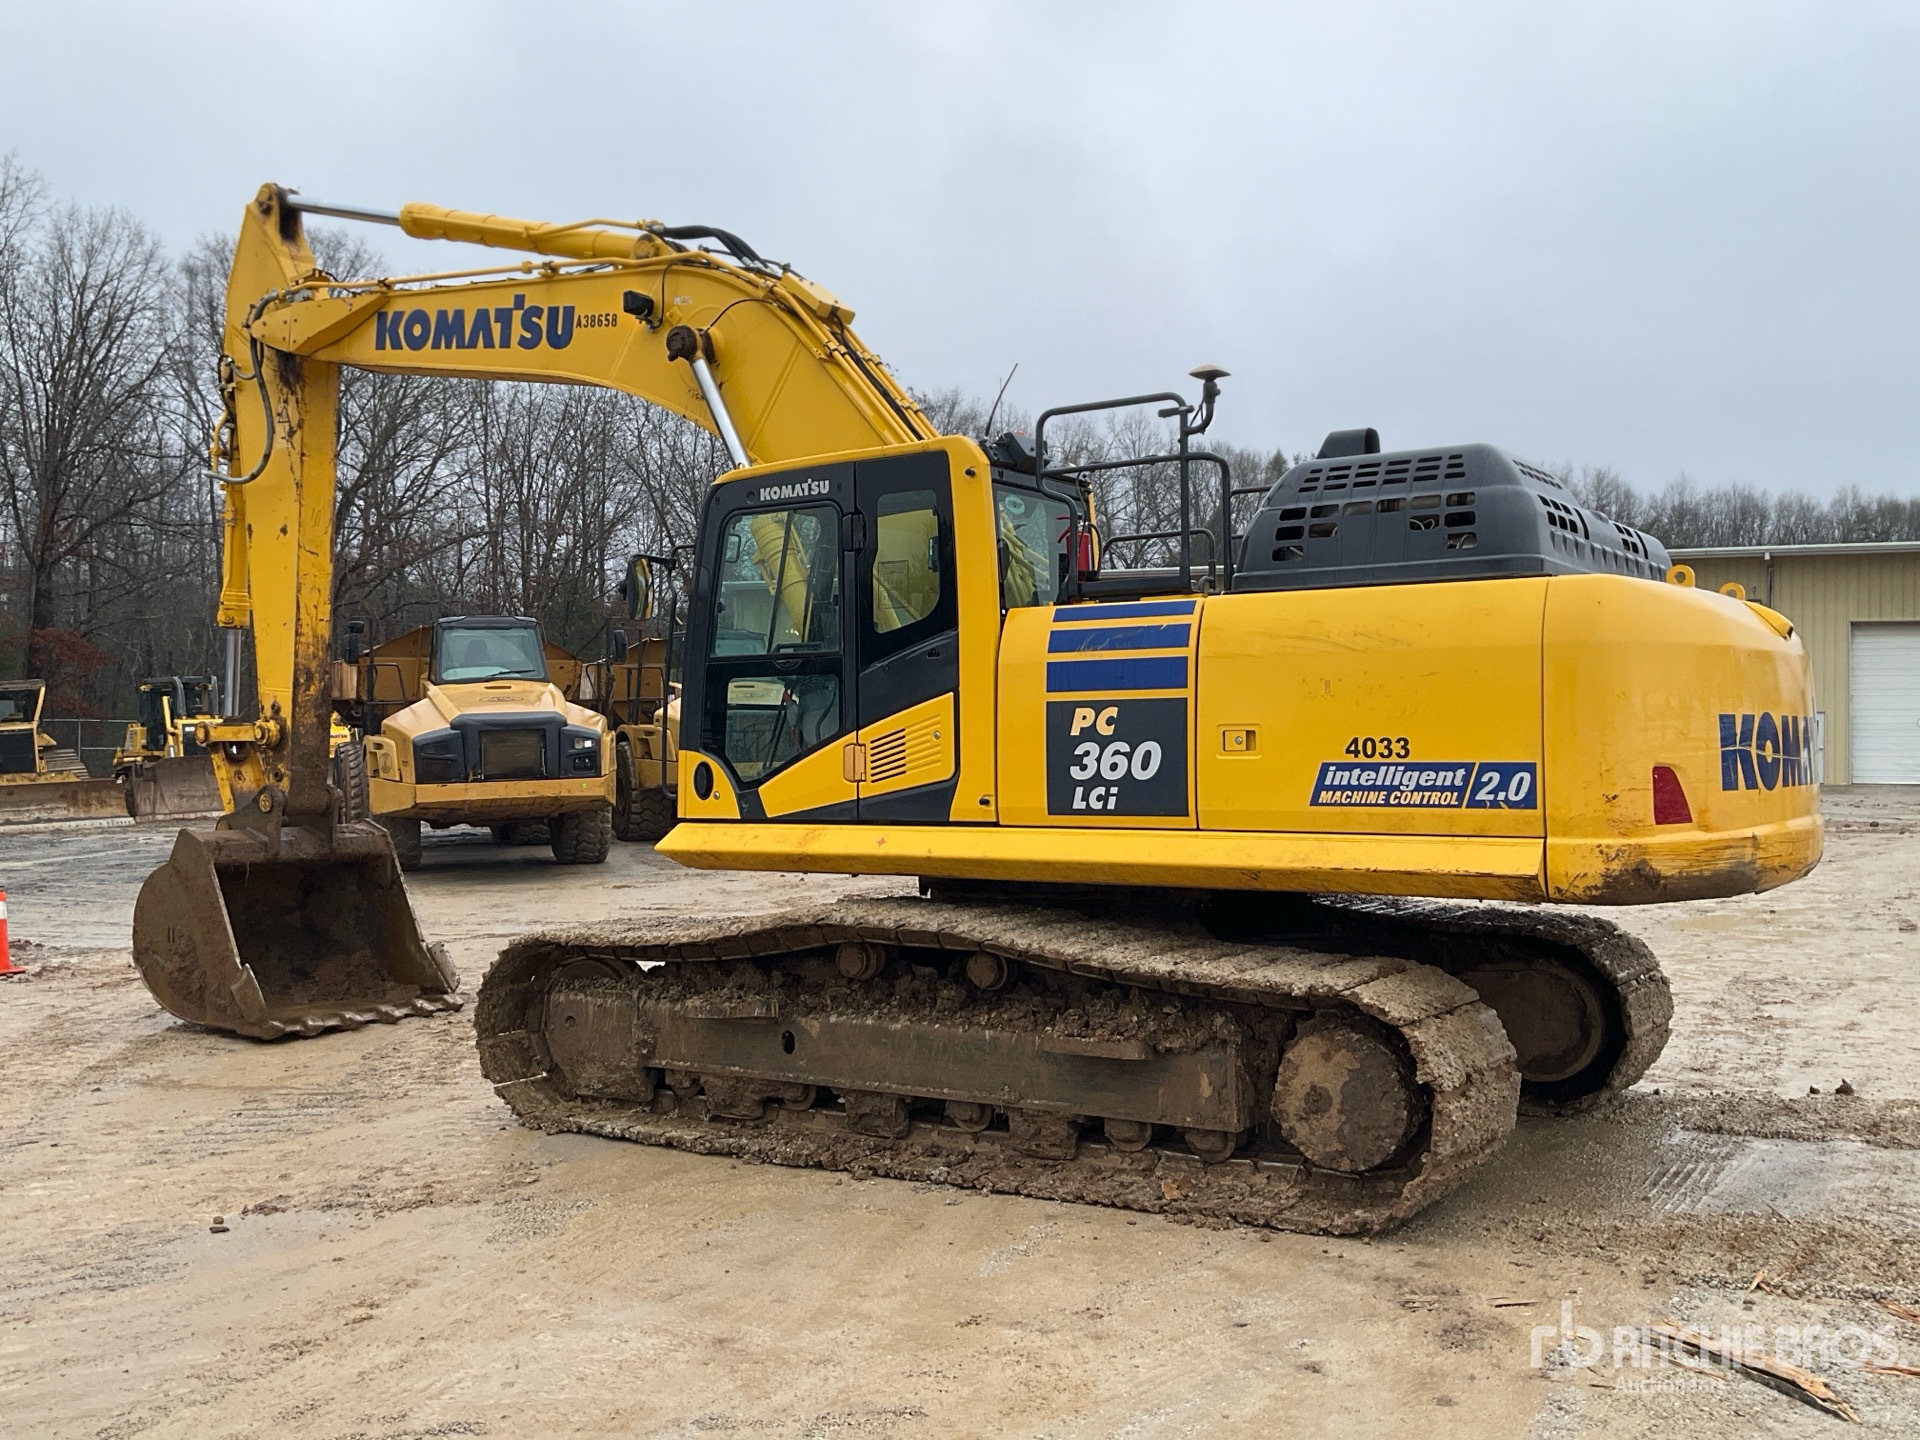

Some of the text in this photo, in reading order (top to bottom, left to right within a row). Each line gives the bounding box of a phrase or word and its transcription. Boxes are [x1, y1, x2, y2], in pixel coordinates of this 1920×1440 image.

[375, 294, 575, 351] KOMATSU
[576, 313, 618, 329] A38658
[760, 478, 830, 501] KOMATSU
[1070, 706, 1119, 736] PC
[1345, 737, 1410, 759] 4033
[1069, 741, 1162, 781] 360
[1324, 765, 1466, 790] intelligent
[1475, 771, 1532, 801] 2.0
[1072, 786, 1119, 810] LCi
[1318, 790, 1459, 805] MACHINE CONTROL
